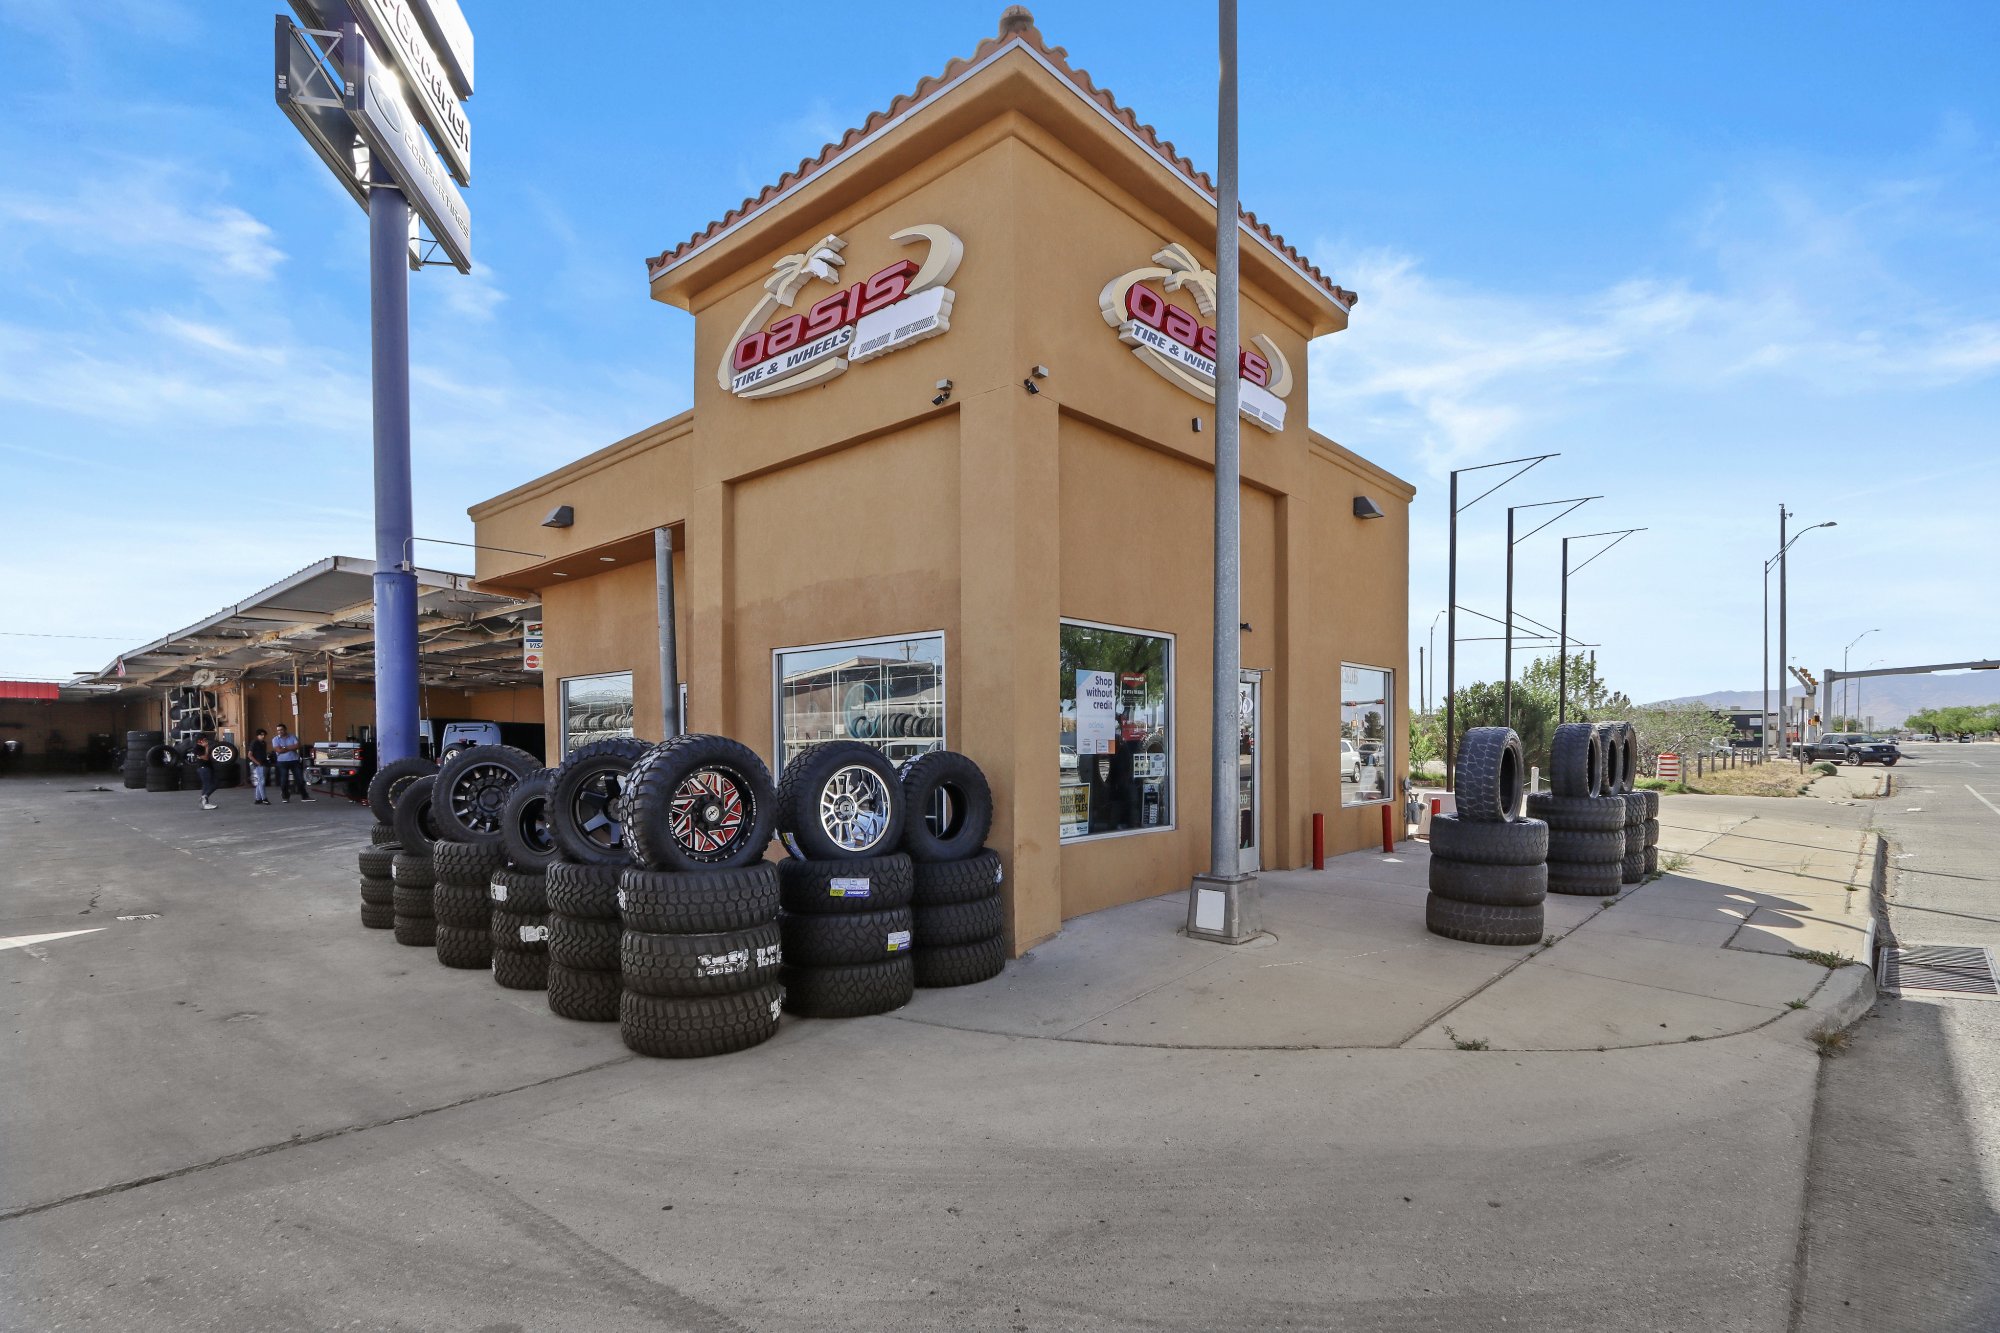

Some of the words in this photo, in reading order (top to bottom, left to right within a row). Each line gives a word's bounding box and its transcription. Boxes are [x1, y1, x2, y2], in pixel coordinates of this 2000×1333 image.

[1133, 323, 1166, 349] TIRE
[1169, 343, 1180, 357] &
[734, 363, 764, 389] TIRE
[766, 362, 779, 375] &
[786, 329, 852, 368] WHEELS
[1095, 675, 1113, 688] Shop
[1086, 687, 1113, 698] without
[1093, 700, 1113, 710] credit
[1060, 795, 1073, 804] TCH
